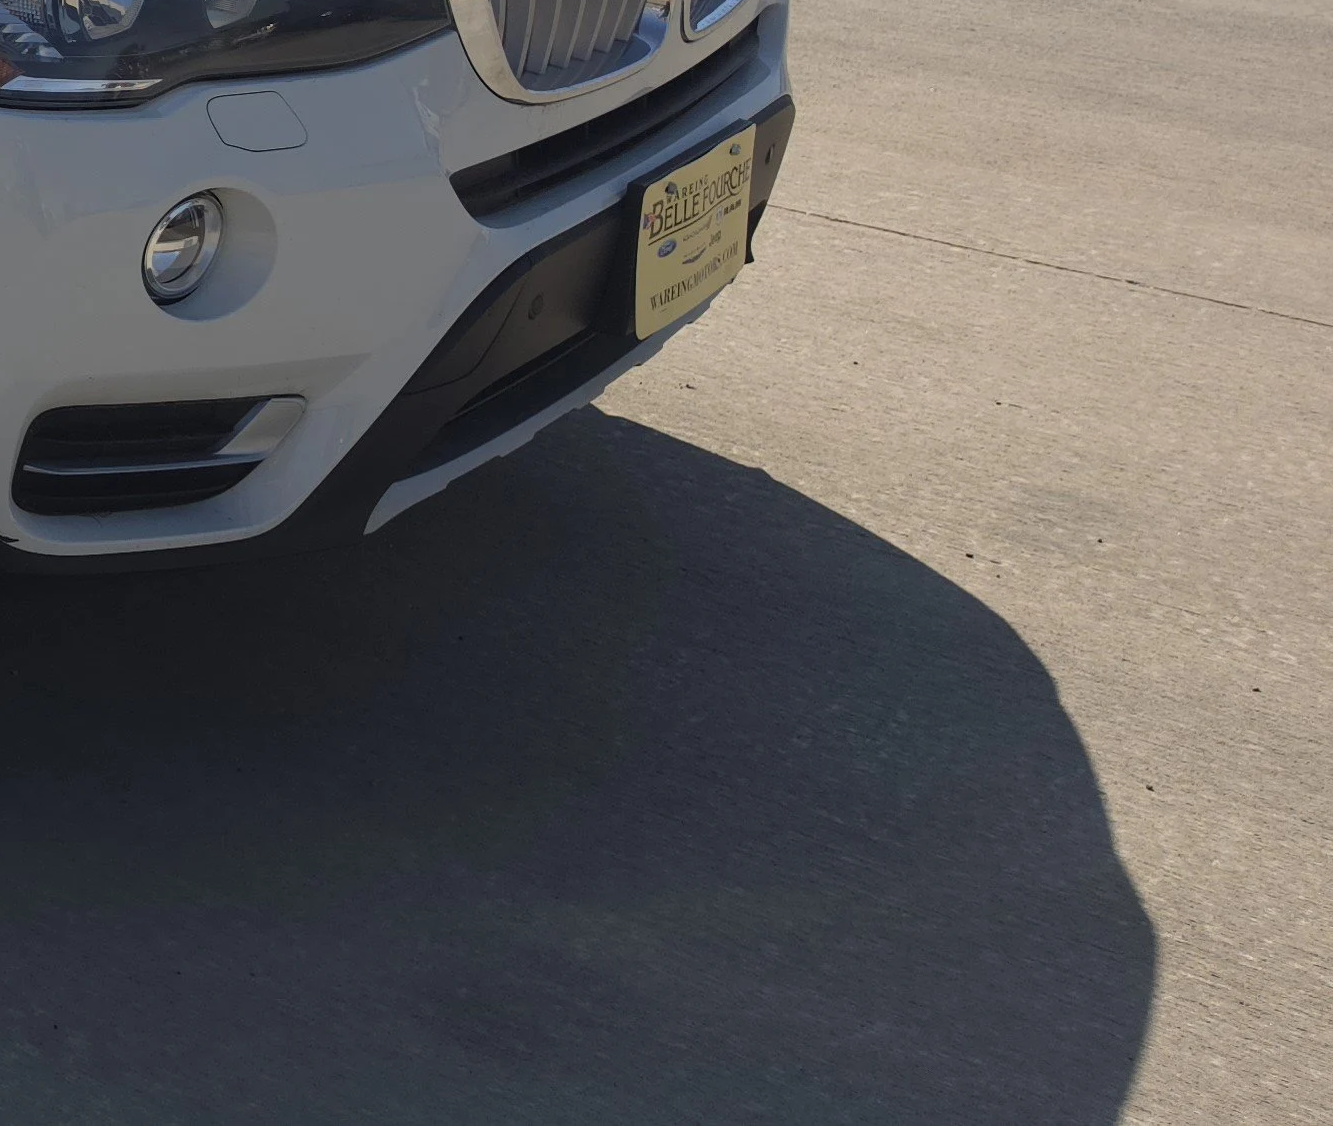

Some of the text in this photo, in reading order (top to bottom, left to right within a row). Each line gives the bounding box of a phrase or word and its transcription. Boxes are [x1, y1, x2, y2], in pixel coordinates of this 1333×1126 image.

[649, 192, 700, 240] BELLE
[702, 158, 751, 212] FOURCHE
[723, 198, 742, 217] RAM
